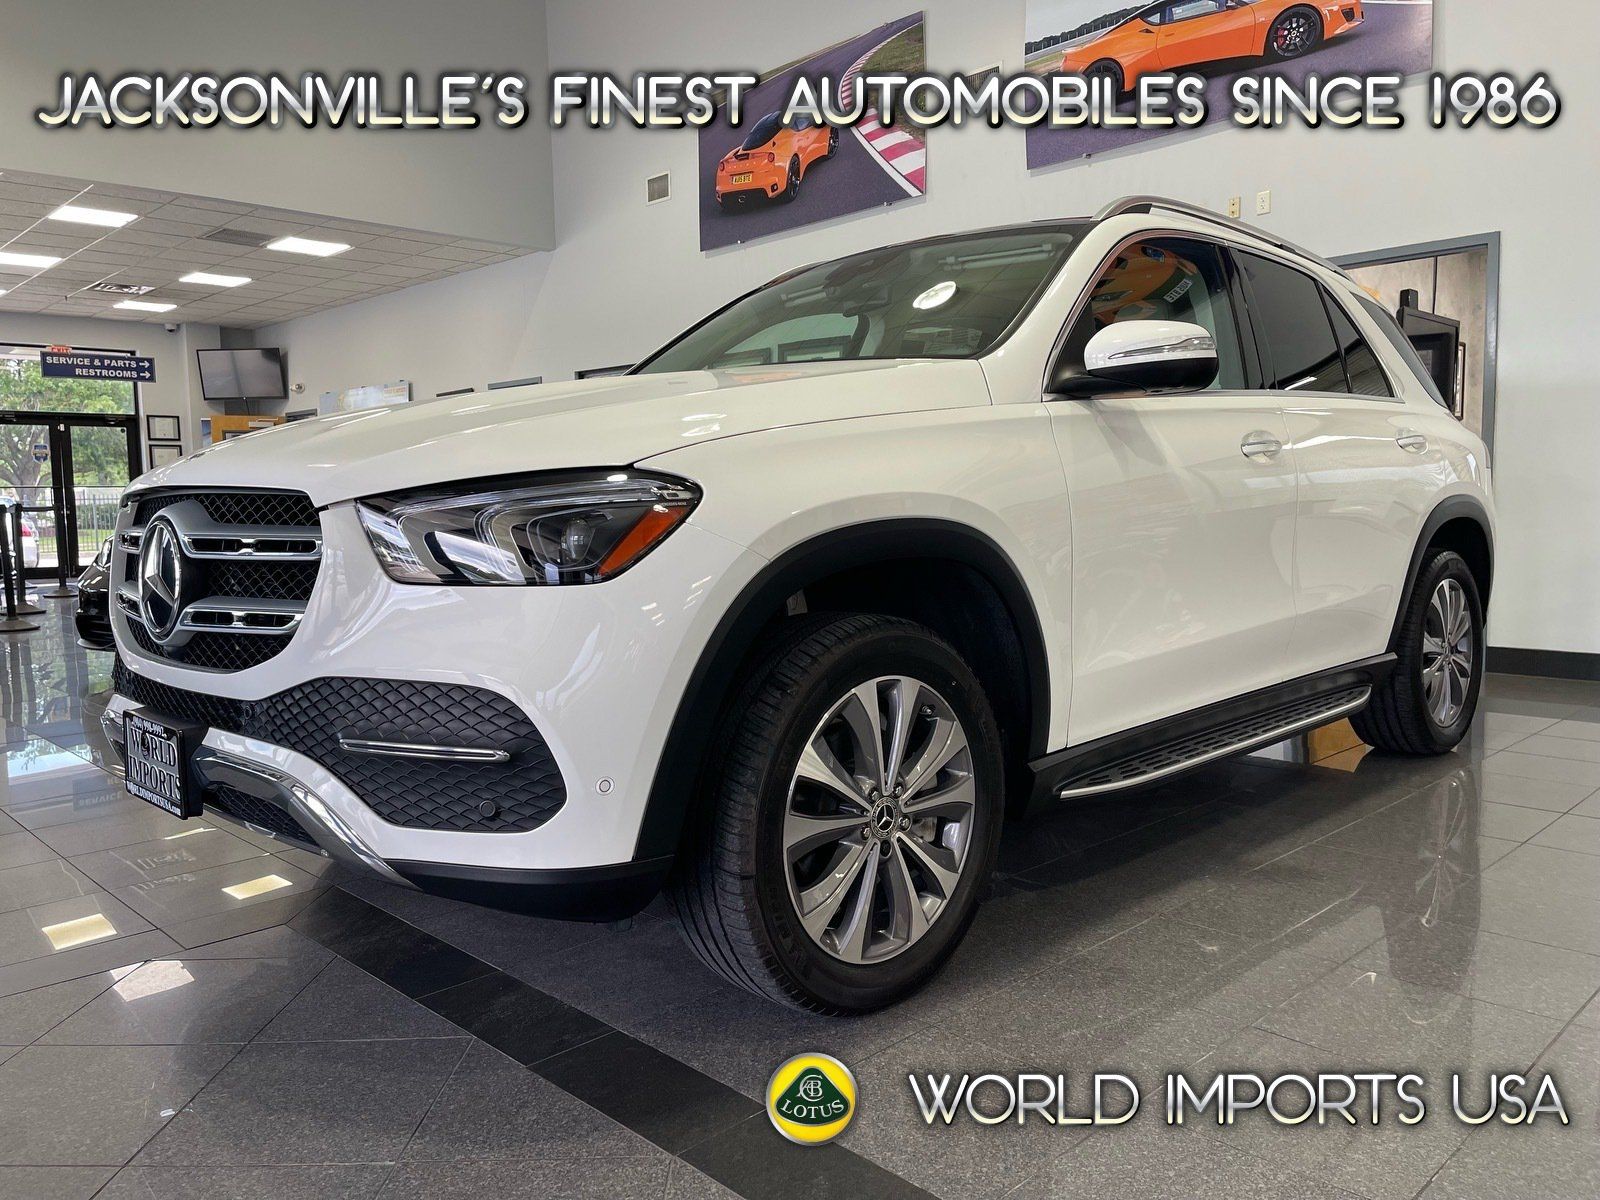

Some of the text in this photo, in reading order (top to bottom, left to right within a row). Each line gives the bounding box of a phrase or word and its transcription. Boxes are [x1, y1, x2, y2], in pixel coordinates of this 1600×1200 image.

[46, 356, 91, 365] SERVICE
[104, 359, 137, 368] PARTS
[75, 368, 138, 378] RESTROOMS
[131, 726, 178, 767] WORLD
[128, 755, 181, 801] IMPORTS
